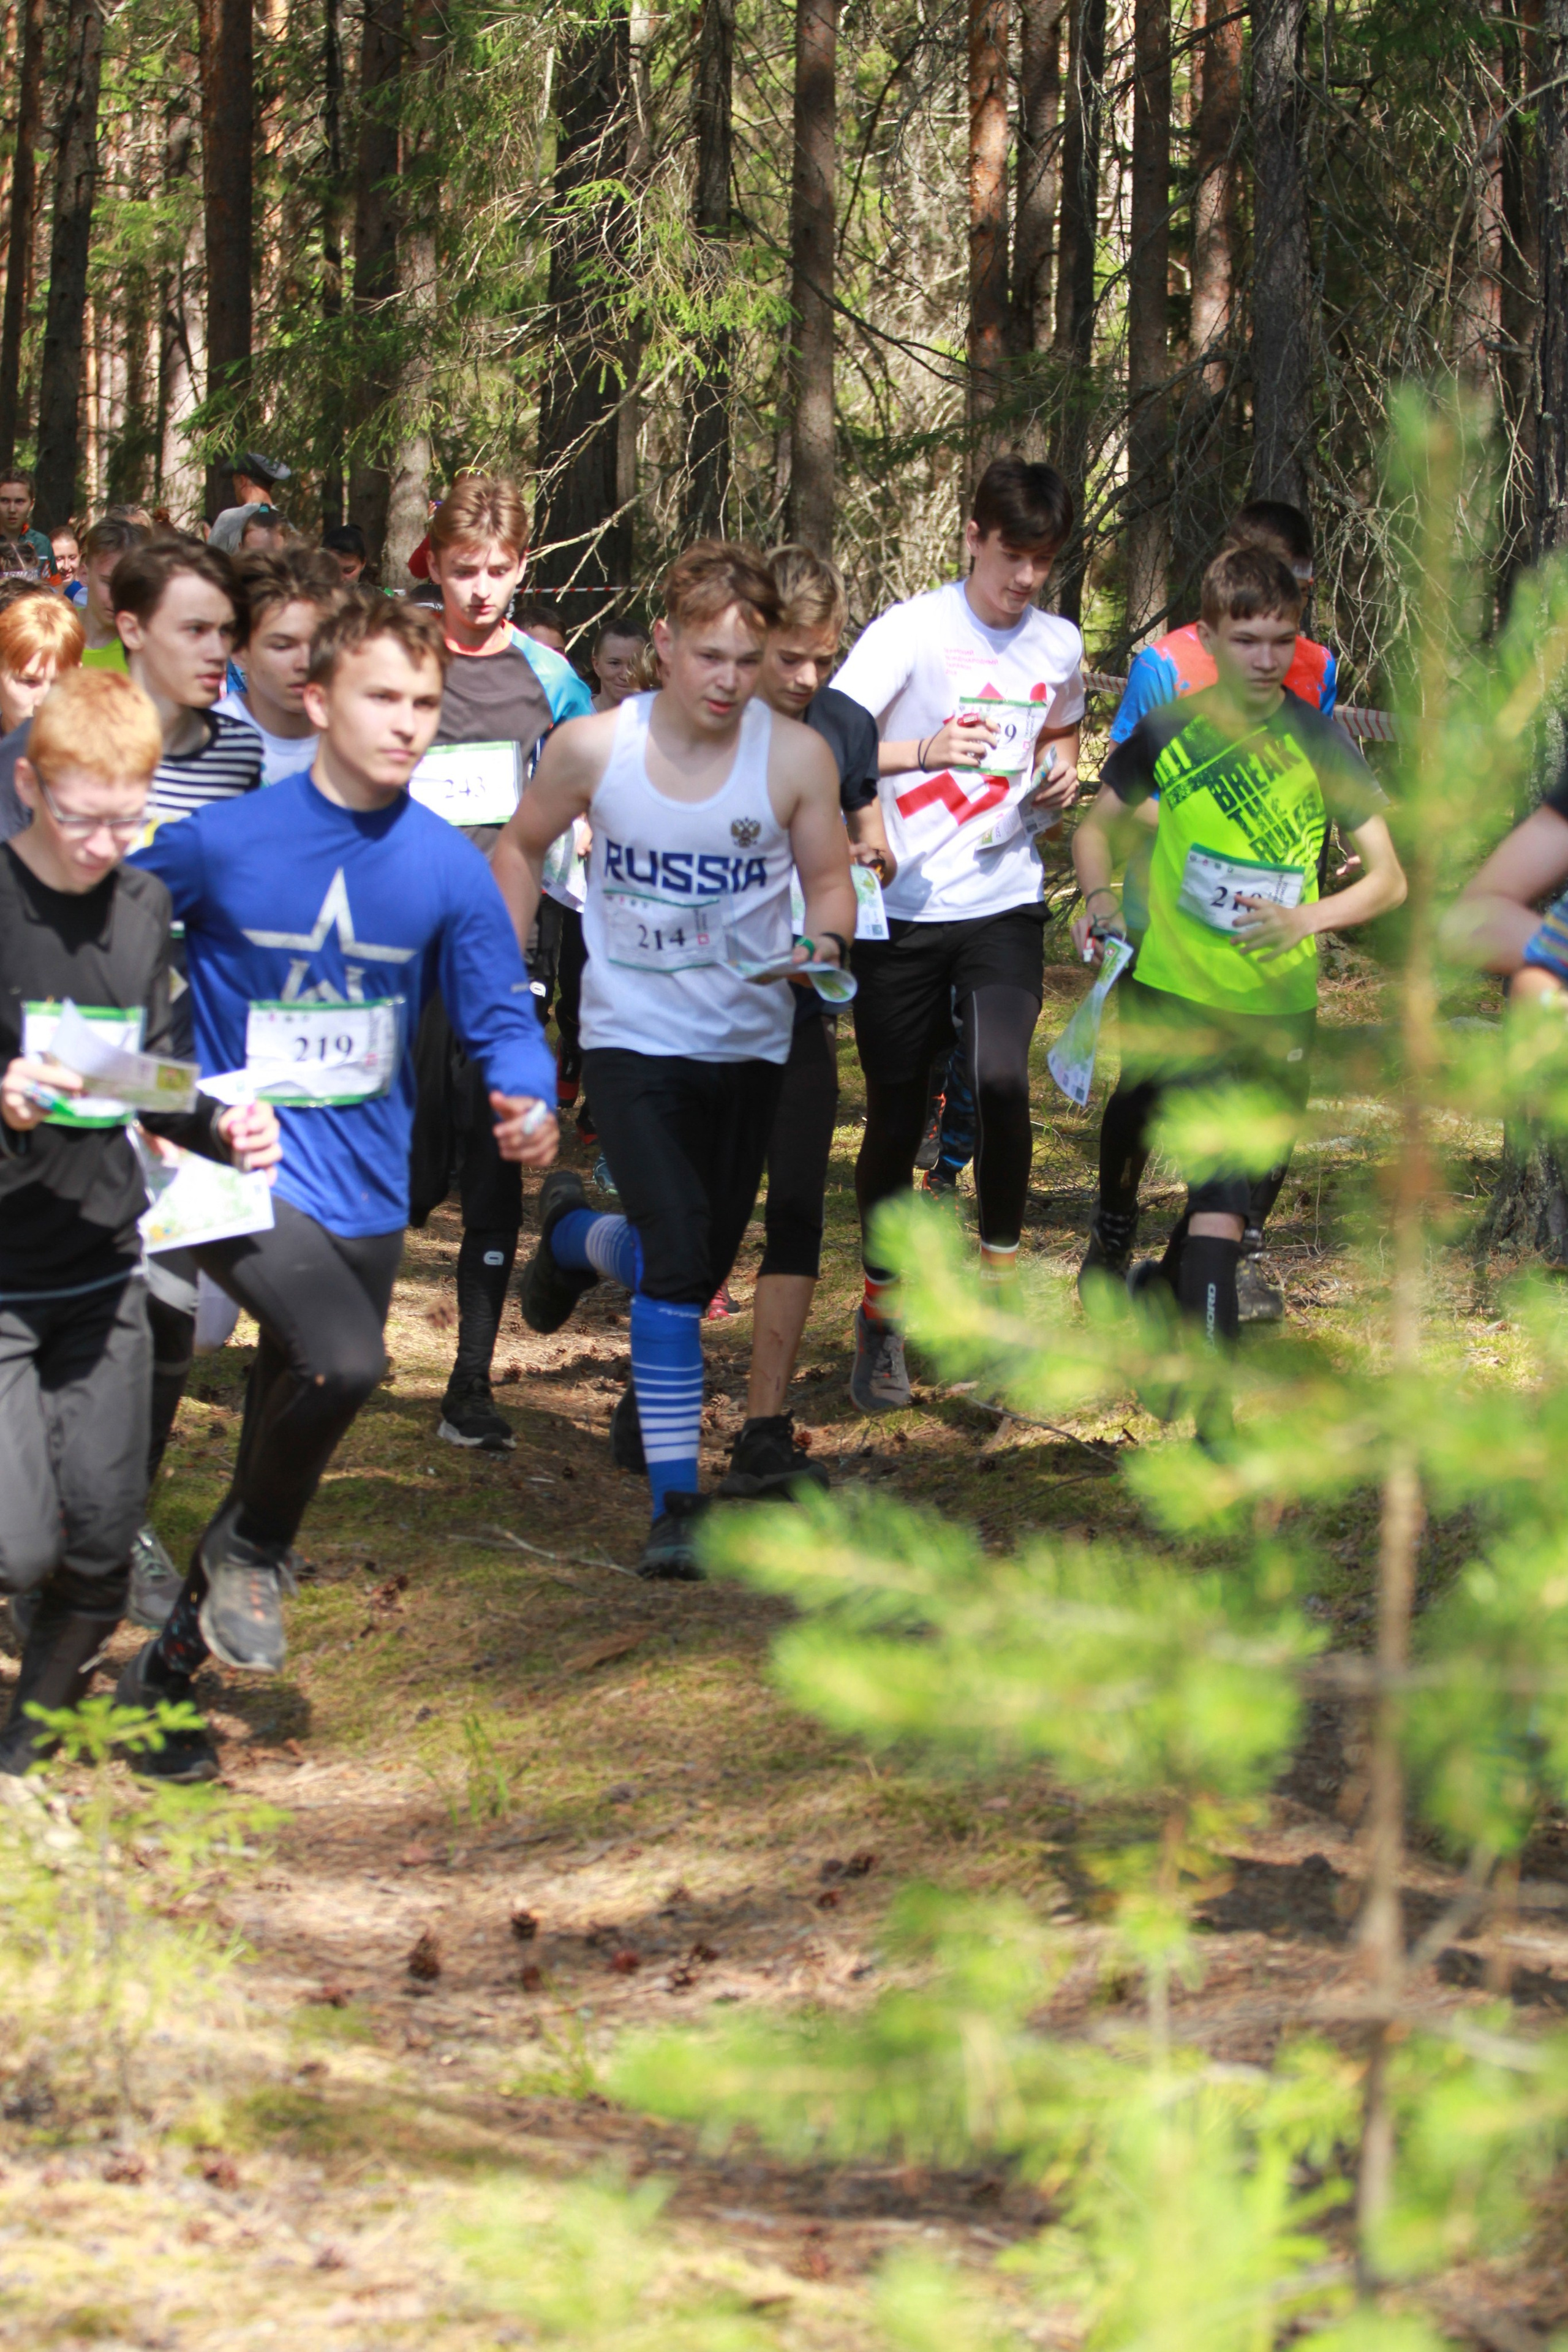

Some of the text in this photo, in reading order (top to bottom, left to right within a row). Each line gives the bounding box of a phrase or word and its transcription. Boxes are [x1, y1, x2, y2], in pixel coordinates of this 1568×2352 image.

[445, 776, 486, 798] 243
[1207, 736, 1305, 815] BREAK
[1227, 795, 1289, 841] THE
[605, 838, 767, 895] RUSSIA
[638, 924, 685, 950] 214
[295, 1035, 354, 1064] 219
